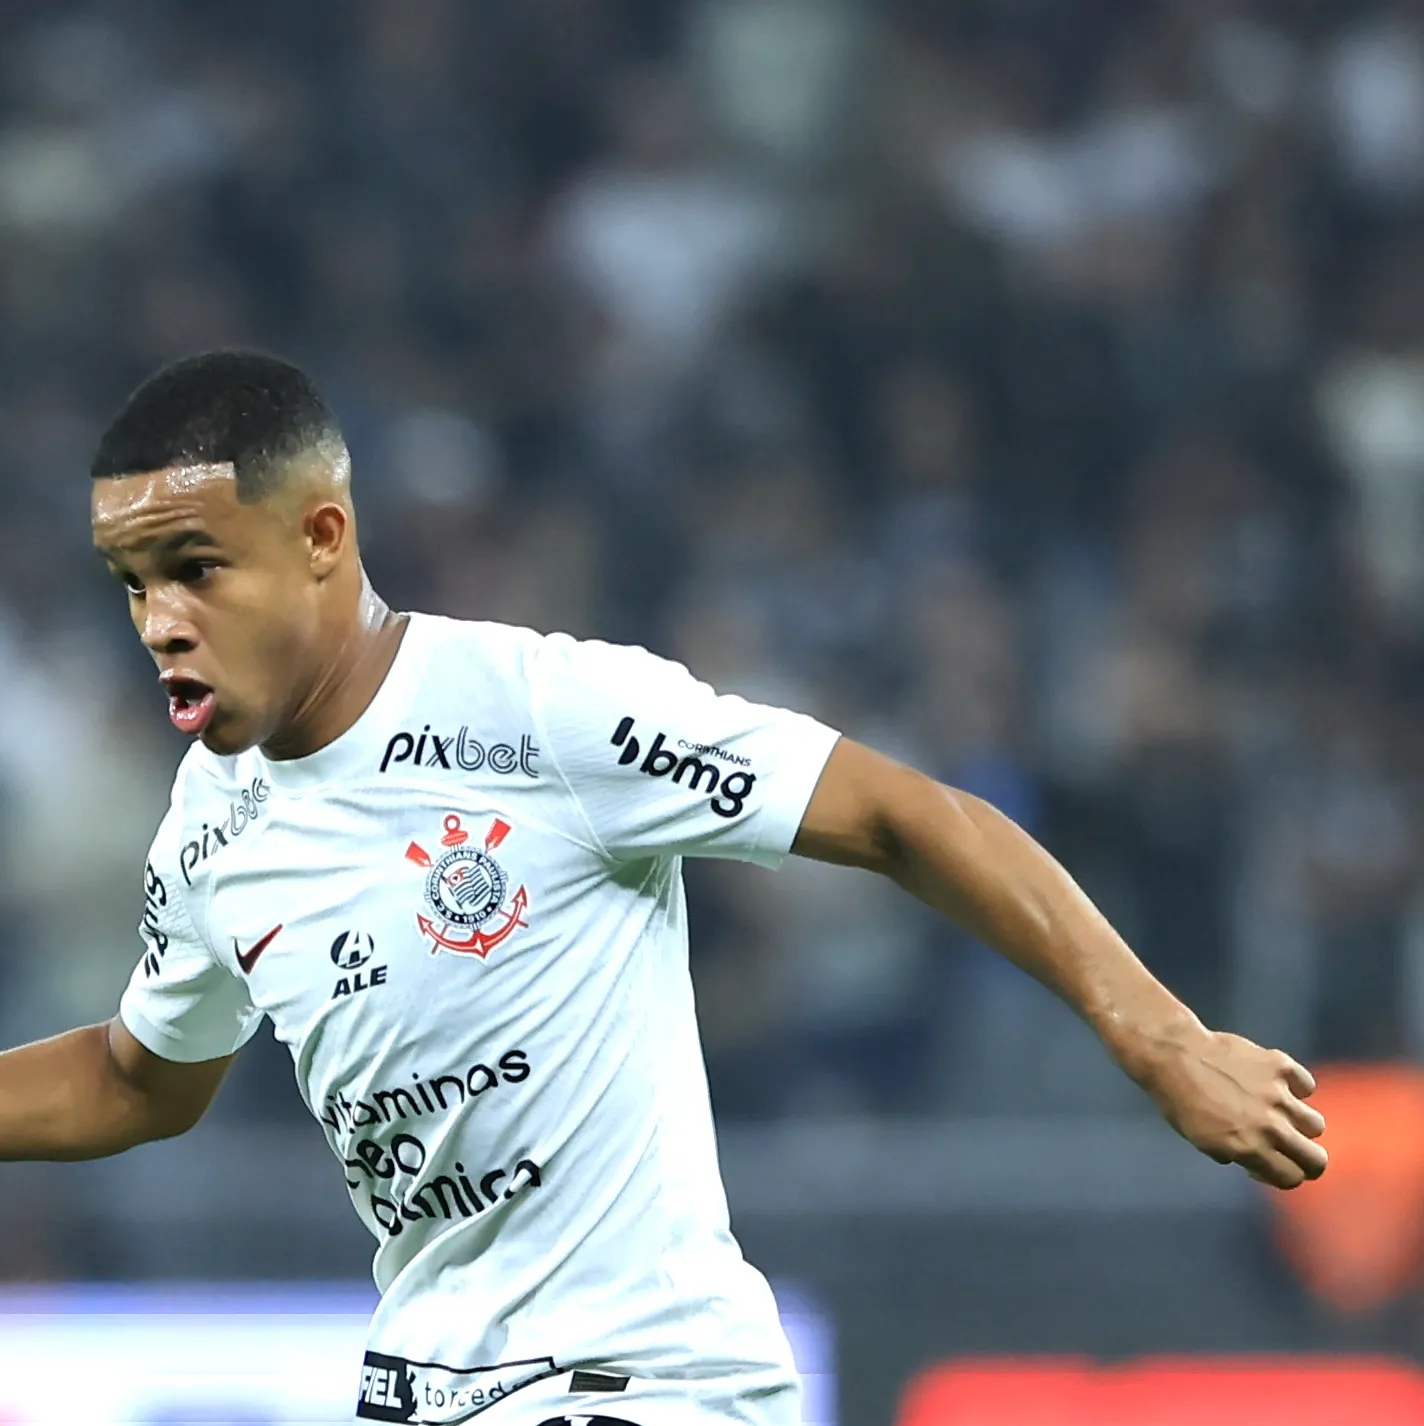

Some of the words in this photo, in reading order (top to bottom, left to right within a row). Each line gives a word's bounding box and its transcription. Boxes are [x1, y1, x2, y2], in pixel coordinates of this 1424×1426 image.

[379, 724, 540, 779] pixbet
[677, 739, 752, 767] CORINTHIANS
[639, 732, 757, 818] bmg
[331, 964, 388, 1000] ALE
[358, 1365, 403, 1409] FIEL
